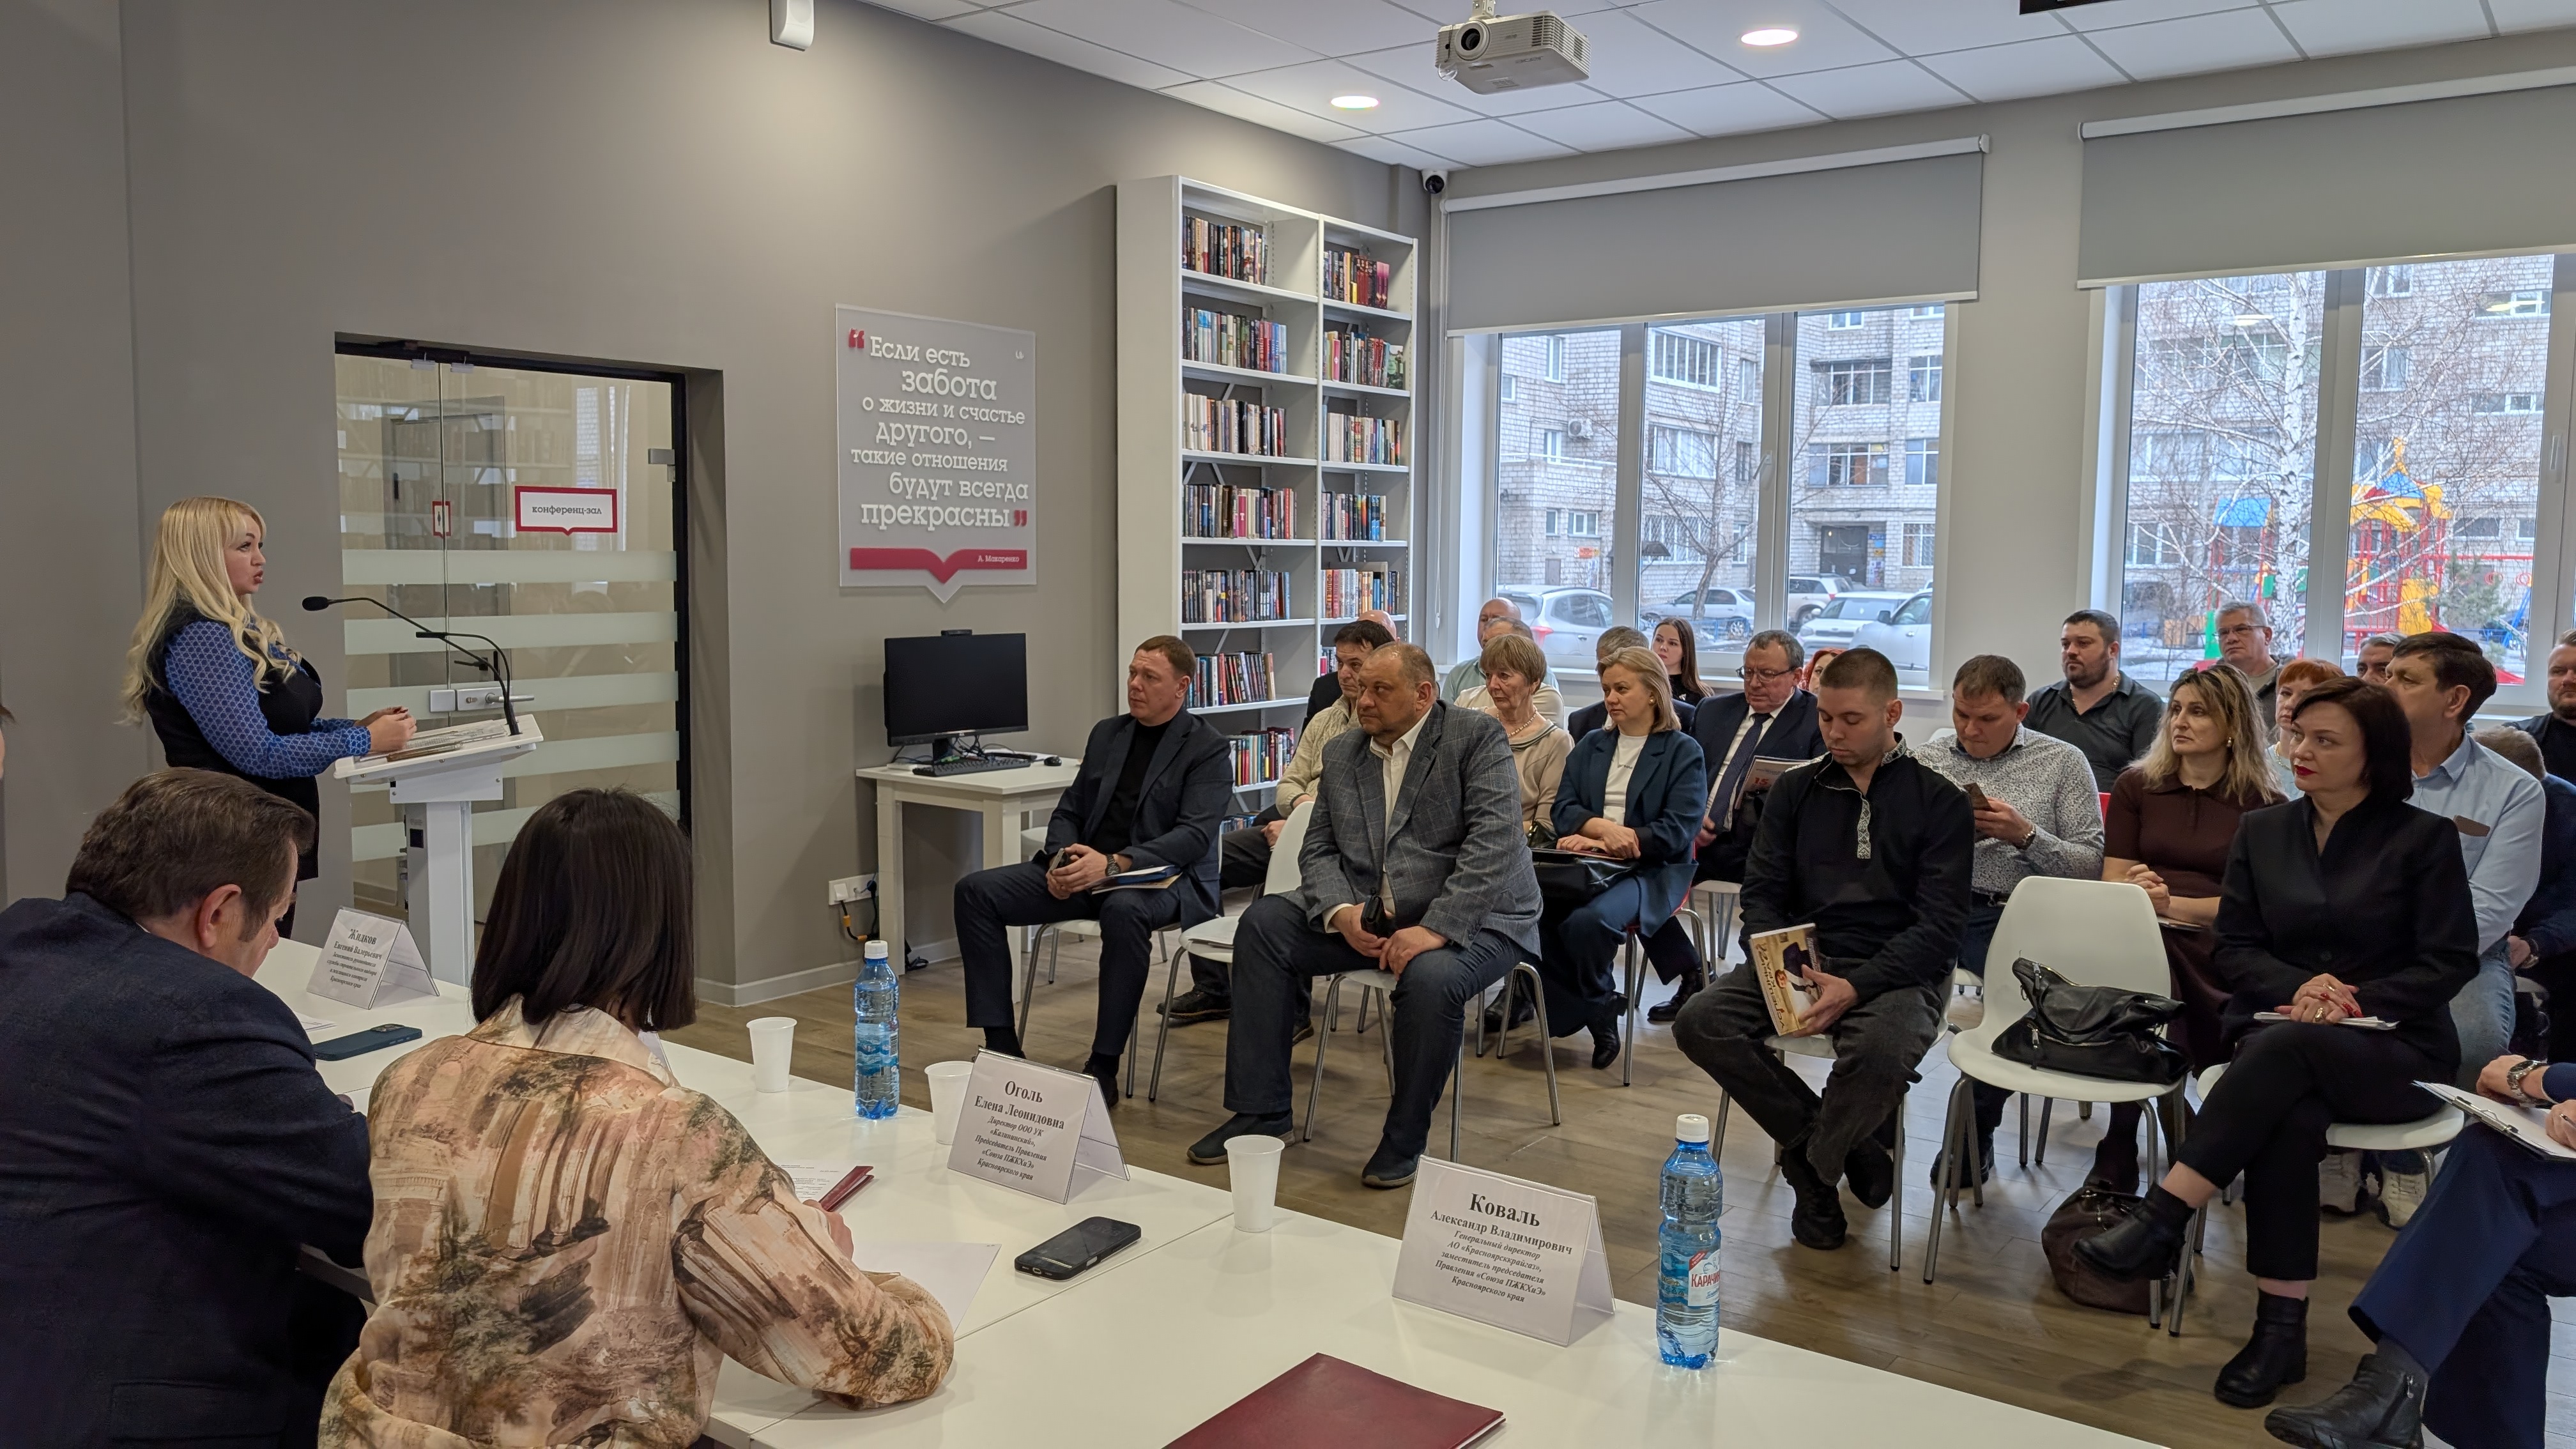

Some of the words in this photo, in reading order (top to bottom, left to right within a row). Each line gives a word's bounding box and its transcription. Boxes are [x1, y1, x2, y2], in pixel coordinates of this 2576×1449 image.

[926, 349, 970, 368] есть
[902, 369, 997, 401] забота
[862, 397, 873, 411] о
[879, 399, 938, 417] жизни
[944, 405, 954, 418] и
[960, 408, 1025, 425] счастье
[876, 422, 972, 449] другого,
[851, 448, 906, 466] такие
[912, 453, 1008, 471] отношения
[889, 472, 952, 501] будут
[959, 480, 1029, 503] всегда
[532, 505, 602, 516] конференц-зал
[348, 928, 377, 944] Жидков
[334, 941, 354, 952] Евгений
[354, 946, 382, 960] Валерьевич
[1005, 1080, 1043, 1103] Оголь
[974, 1095, 1003, 1114] Елена
[1005, 1103, 1064, 1130] Леонидовна
[987, 1116, 1017, 1131] Директор
[1018, 1124, 1032, 1133] ООО
[1033, 1128, 1044, 1137] УК
[990, 1128, 1036, 1147] «Калининский»,
[975, 1135, 1015, 1152] Председатель
[1015, 1146, 1047, 1161] Правления
[982, 1149, 1003, 1160] «Союза
[977, 1158, 1019, 1176] Красноярского
[1019, 1172, 1034, 1181] края
[1468, 1192, 1540, 1227] Коваль
[1430, 1209, 1487, 1234] Александр
[1490, 1224, 1573, 1255] Владимирович
[1453, 1230, 1503, 1250] Генеральный
[1503, 1242, 1541, 1260] директор
[1441, 1250, 1491, 1270] заместитель
[1492, 1264, 1545, 1285] председателя
[1447, 1241, 1460, 1250] АО
[1461, 1243, 1542, 1273] «Красноярсккрайгаз»,
[1435, 1259, 1475, 1277] Правления
[1476, 1271, 1504, 1285] «Союза
[1505, 1278, 1546, 1297] ПЖКХиЭ»
[1451, 1276, 1506, 1298] Красноярского
[1506, 1289, 1525, 1303] края
